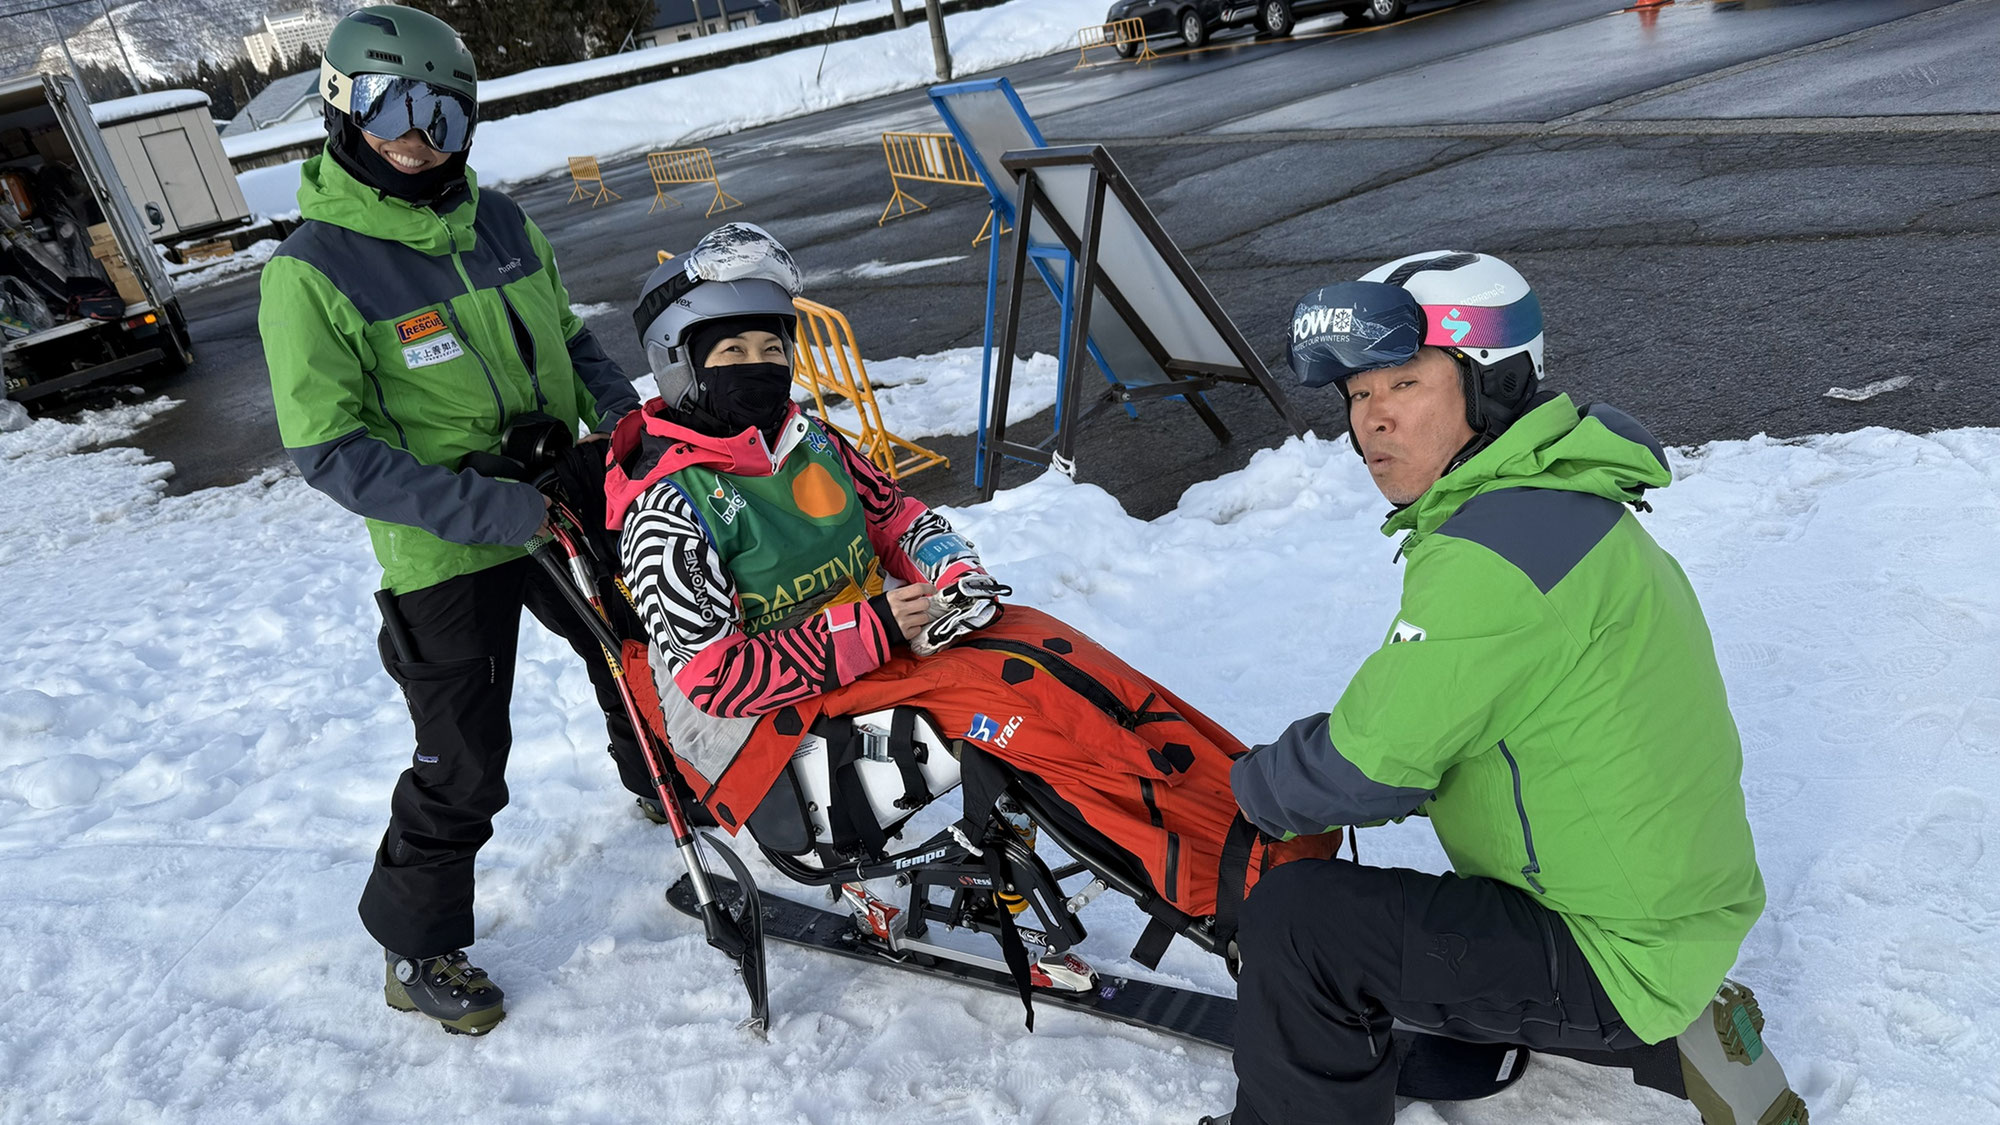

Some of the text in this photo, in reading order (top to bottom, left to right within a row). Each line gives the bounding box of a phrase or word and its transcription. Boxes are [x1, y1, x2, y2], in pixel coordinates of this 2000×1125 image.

[405, 317, 441, 336] RESCUE
[1294, 308, 1334, 343] POW
[1320, 335, 1350, 343] WINTERS
[738, 535, 864, 619] DAPTIVE
[893, 848, 947, 870] Tempo
